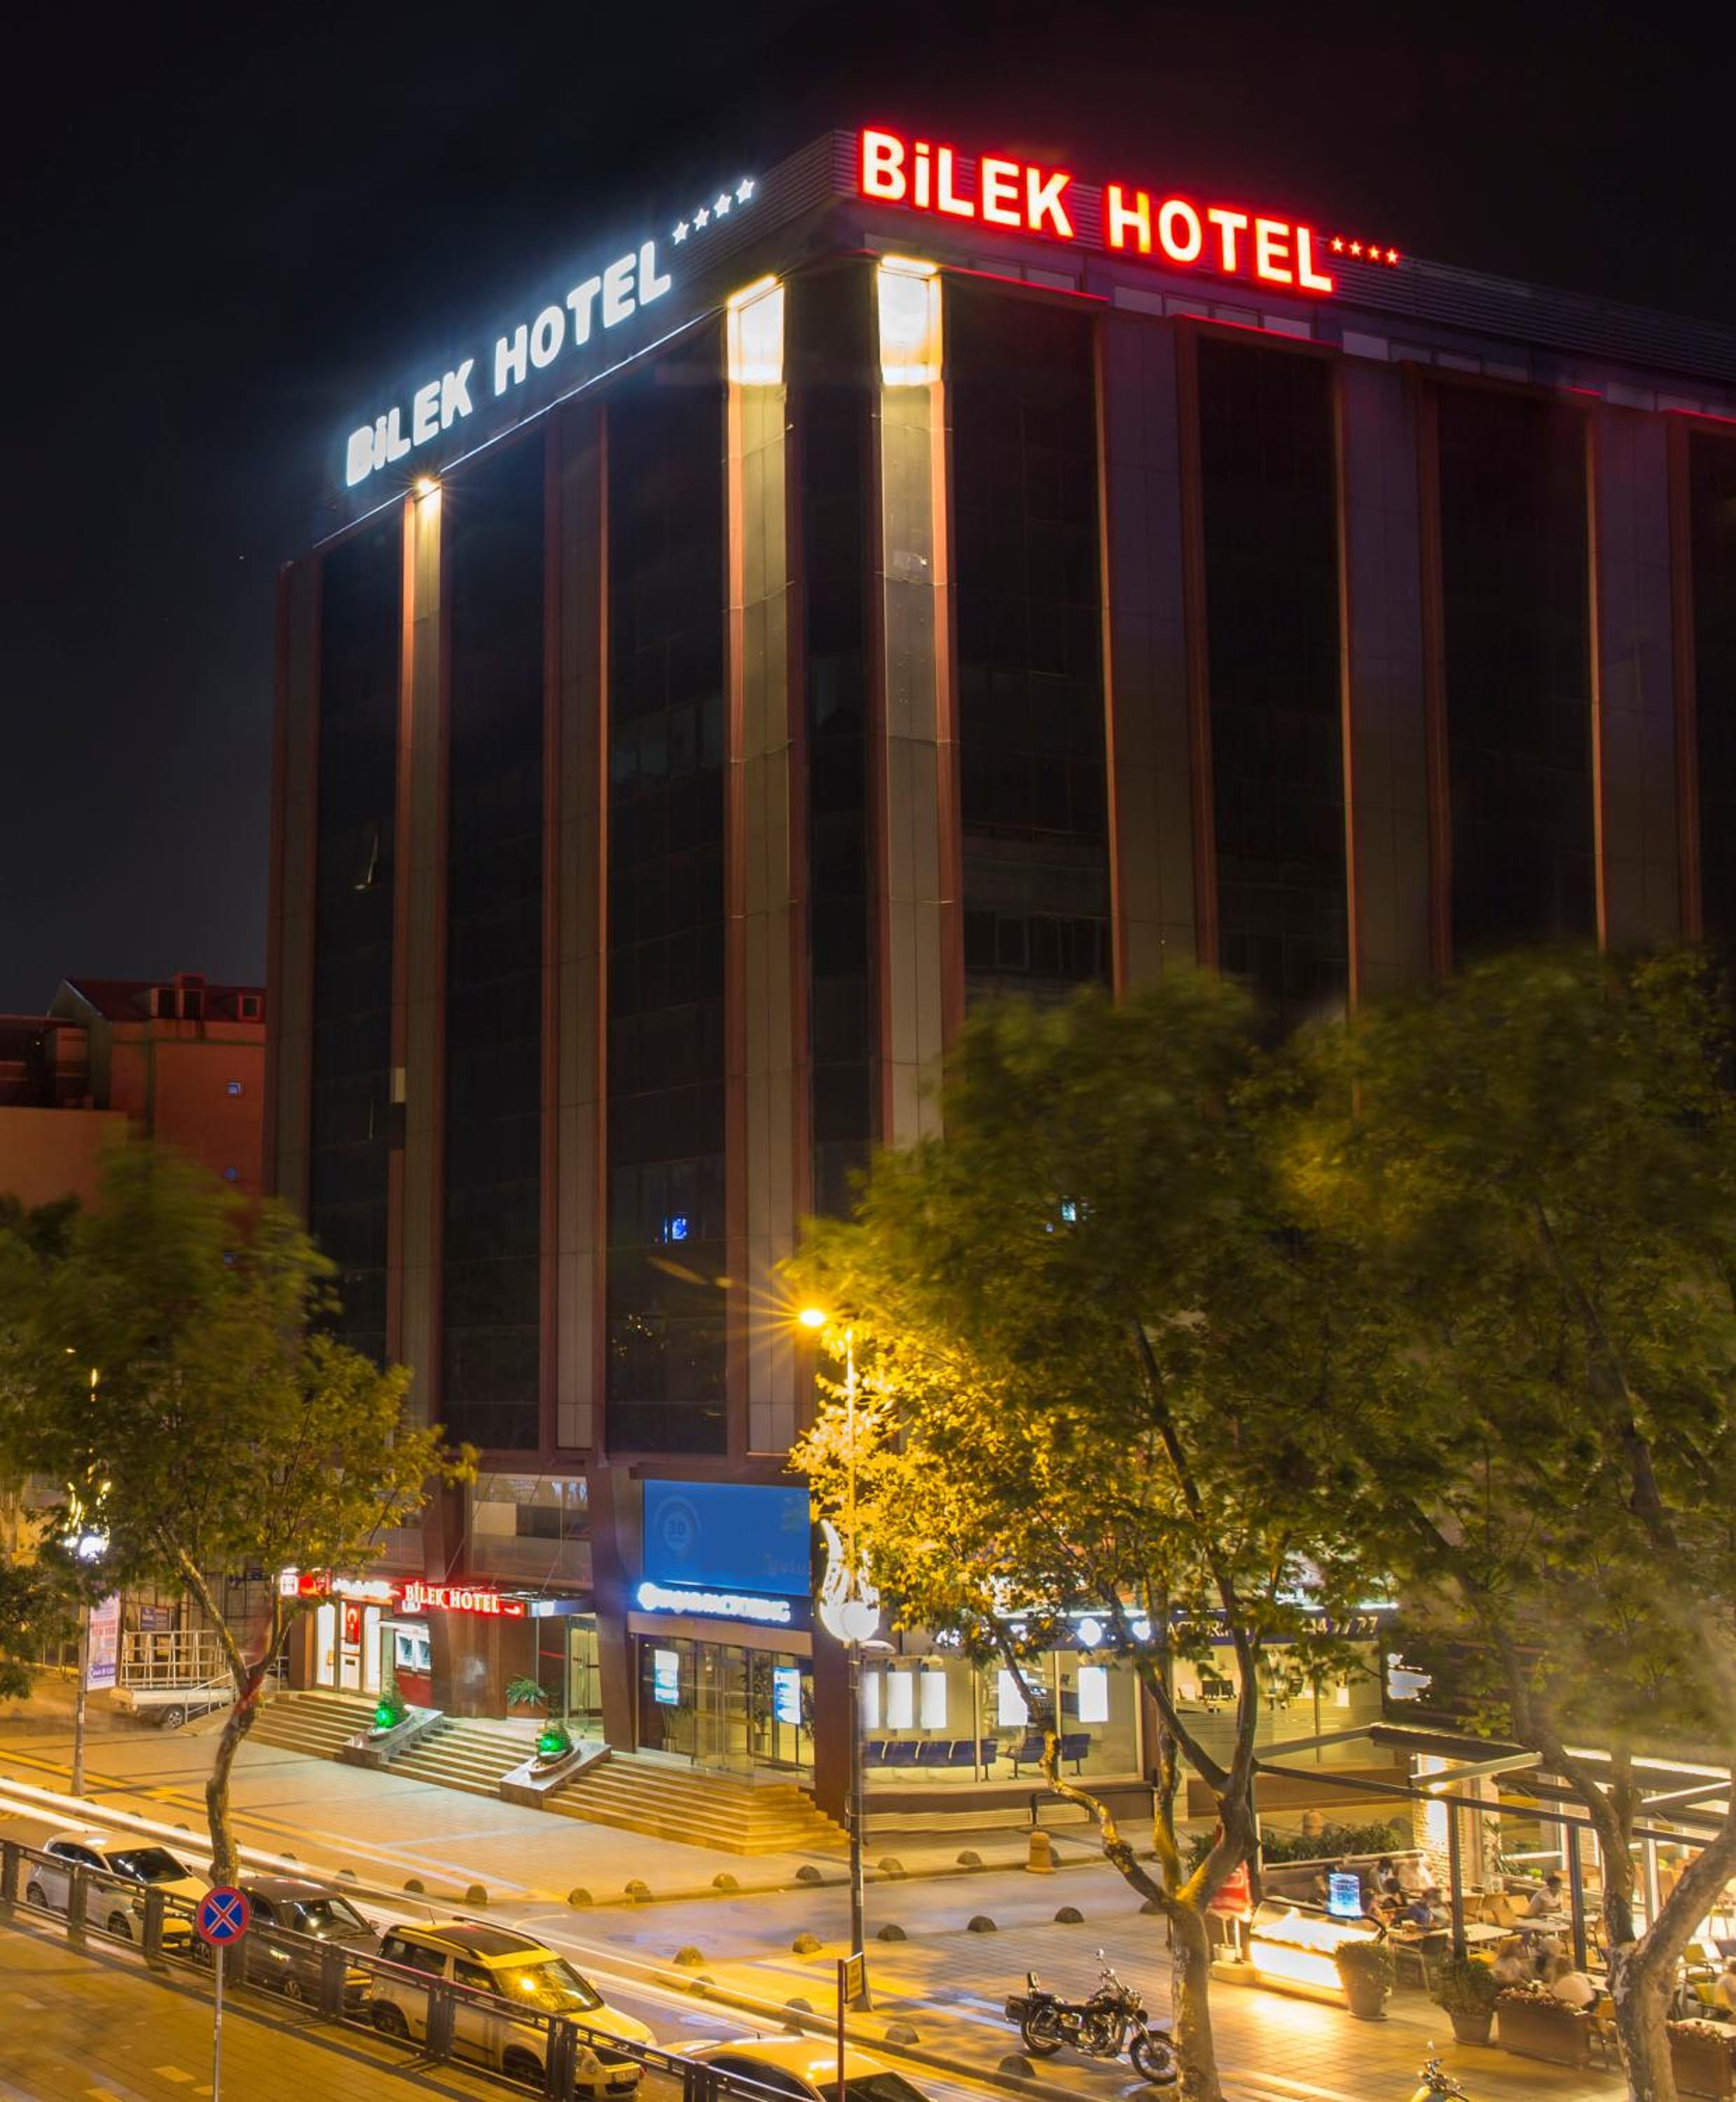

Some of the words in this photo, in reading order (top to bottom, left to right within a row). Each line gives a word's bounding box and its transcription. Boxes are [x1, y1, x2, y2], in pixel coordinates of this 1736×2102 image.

[1108, 186, 1333, 292] HOTEL
[494, 240, 673, 397] HOTEL
[449, 1590, 500, 1613] HOTEL
